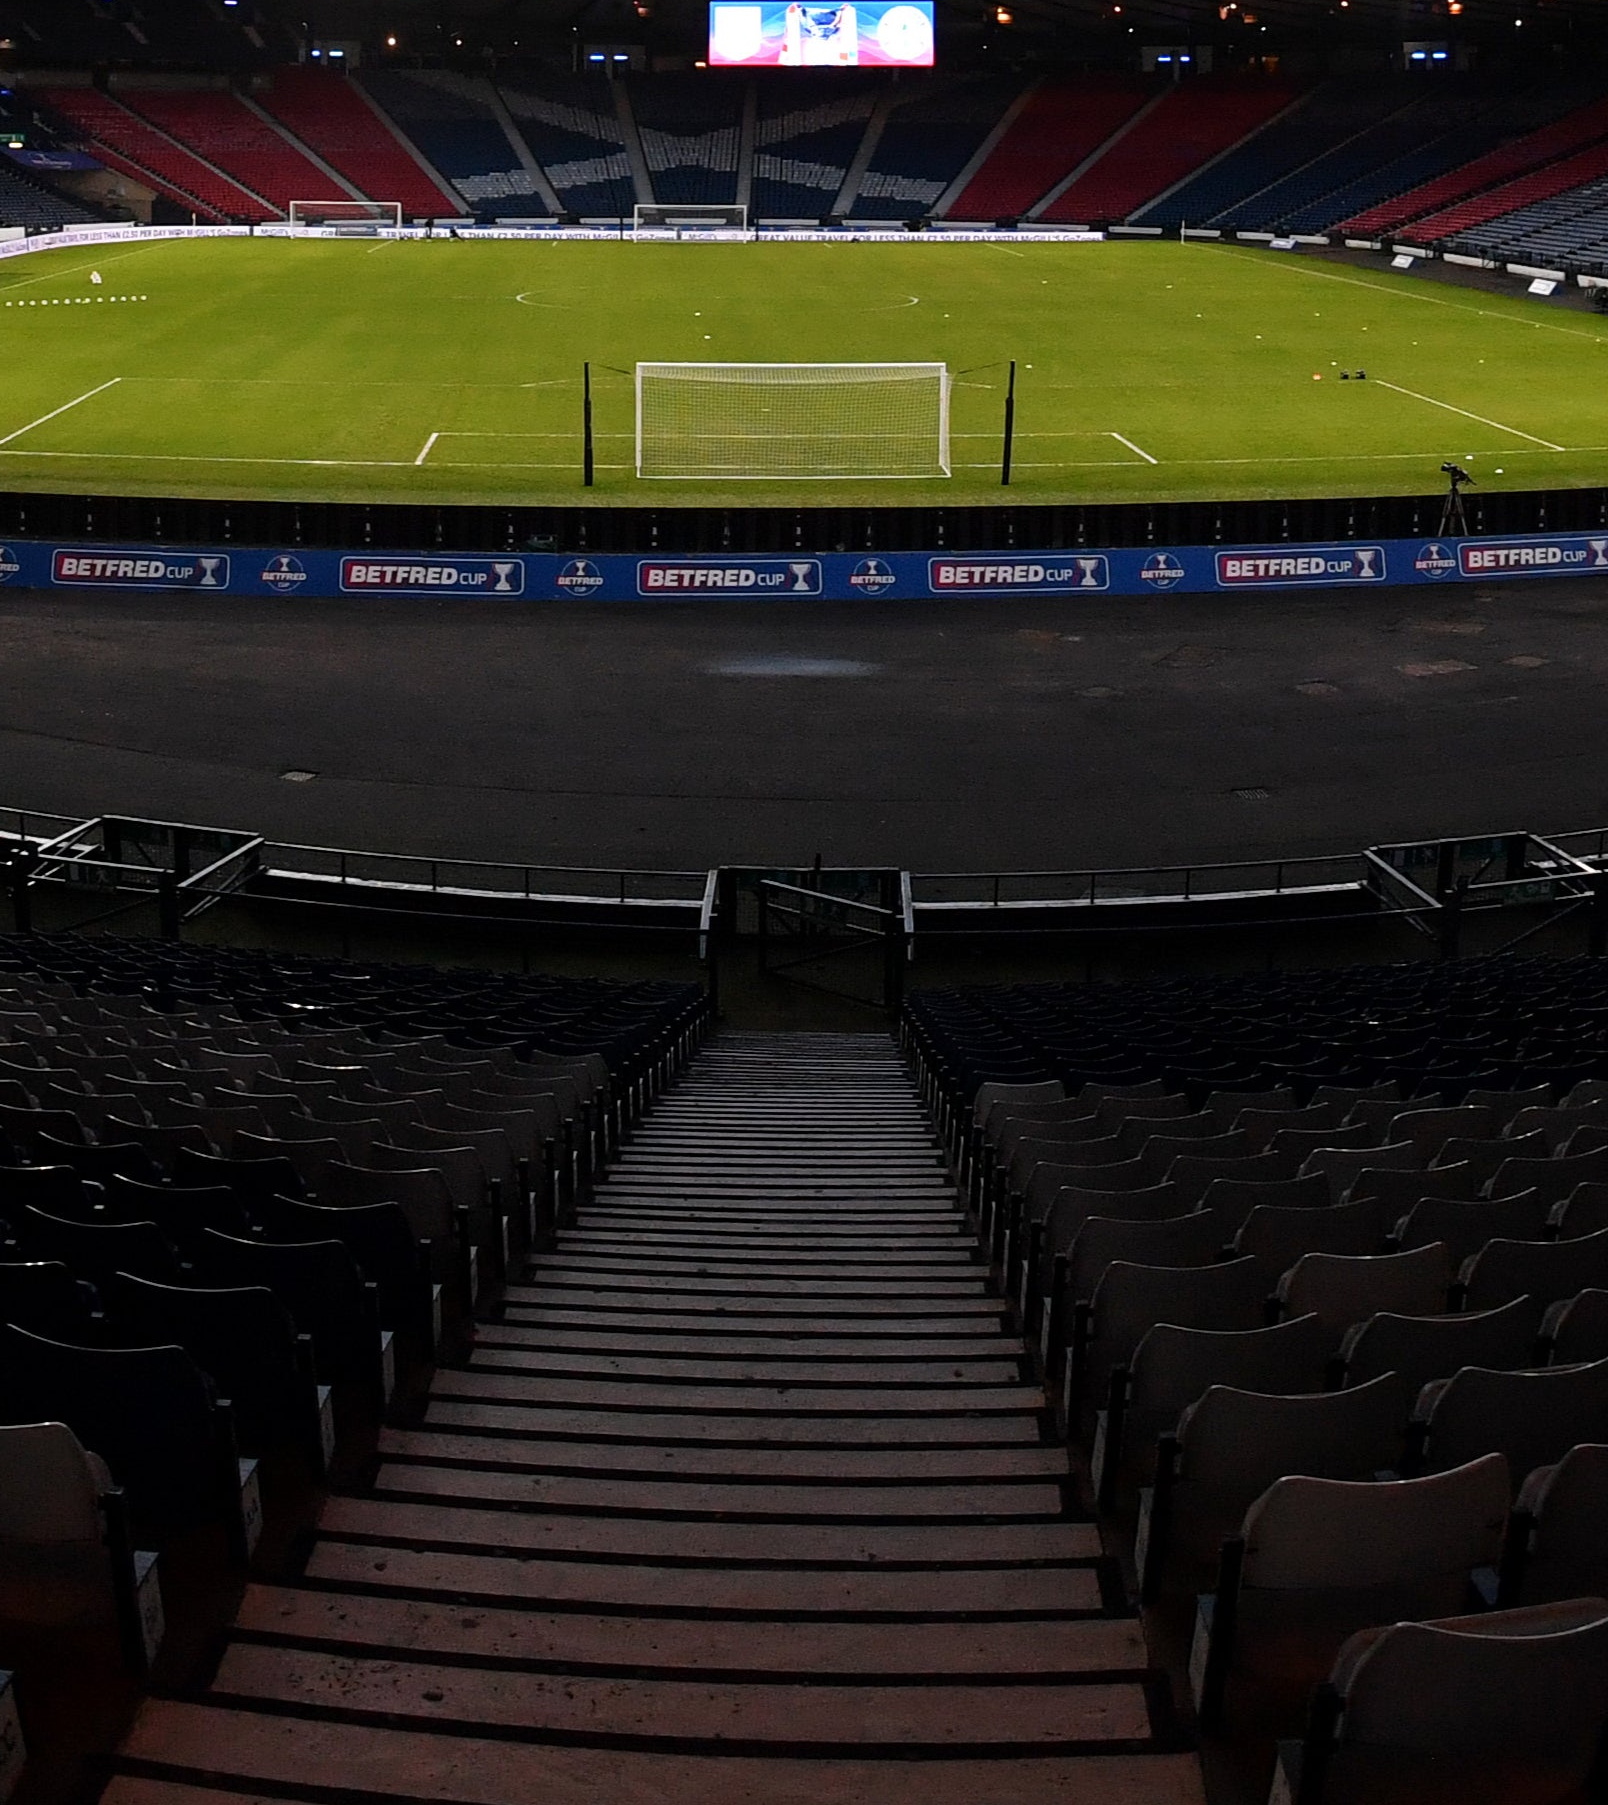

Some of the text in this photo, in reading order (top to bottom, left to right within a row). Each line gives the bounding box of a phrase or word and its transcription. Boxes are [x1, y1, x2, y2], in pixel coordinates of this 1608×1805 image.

[1416, 558, 1455, 569] BETFRED
[1468, 547, 1587, 568] BETFRED CUP
[61, 558, 193, 579] BETFRED CUP
[261, 571, 306, 582] BETFRED
[349, 565, 487, 585] BETFRED CUP
[938, 565, 1072, 584] BETFRED CUP
[1141, 569, 1184, 579] BETFRED
[1225, 557, 1352, 578] BETFRED CUP
[557, 577, 603, 586] BETFRED
[647, 568, 784, 587] BETFRED CUP
[851, 574, 895, 584] BETFRED
